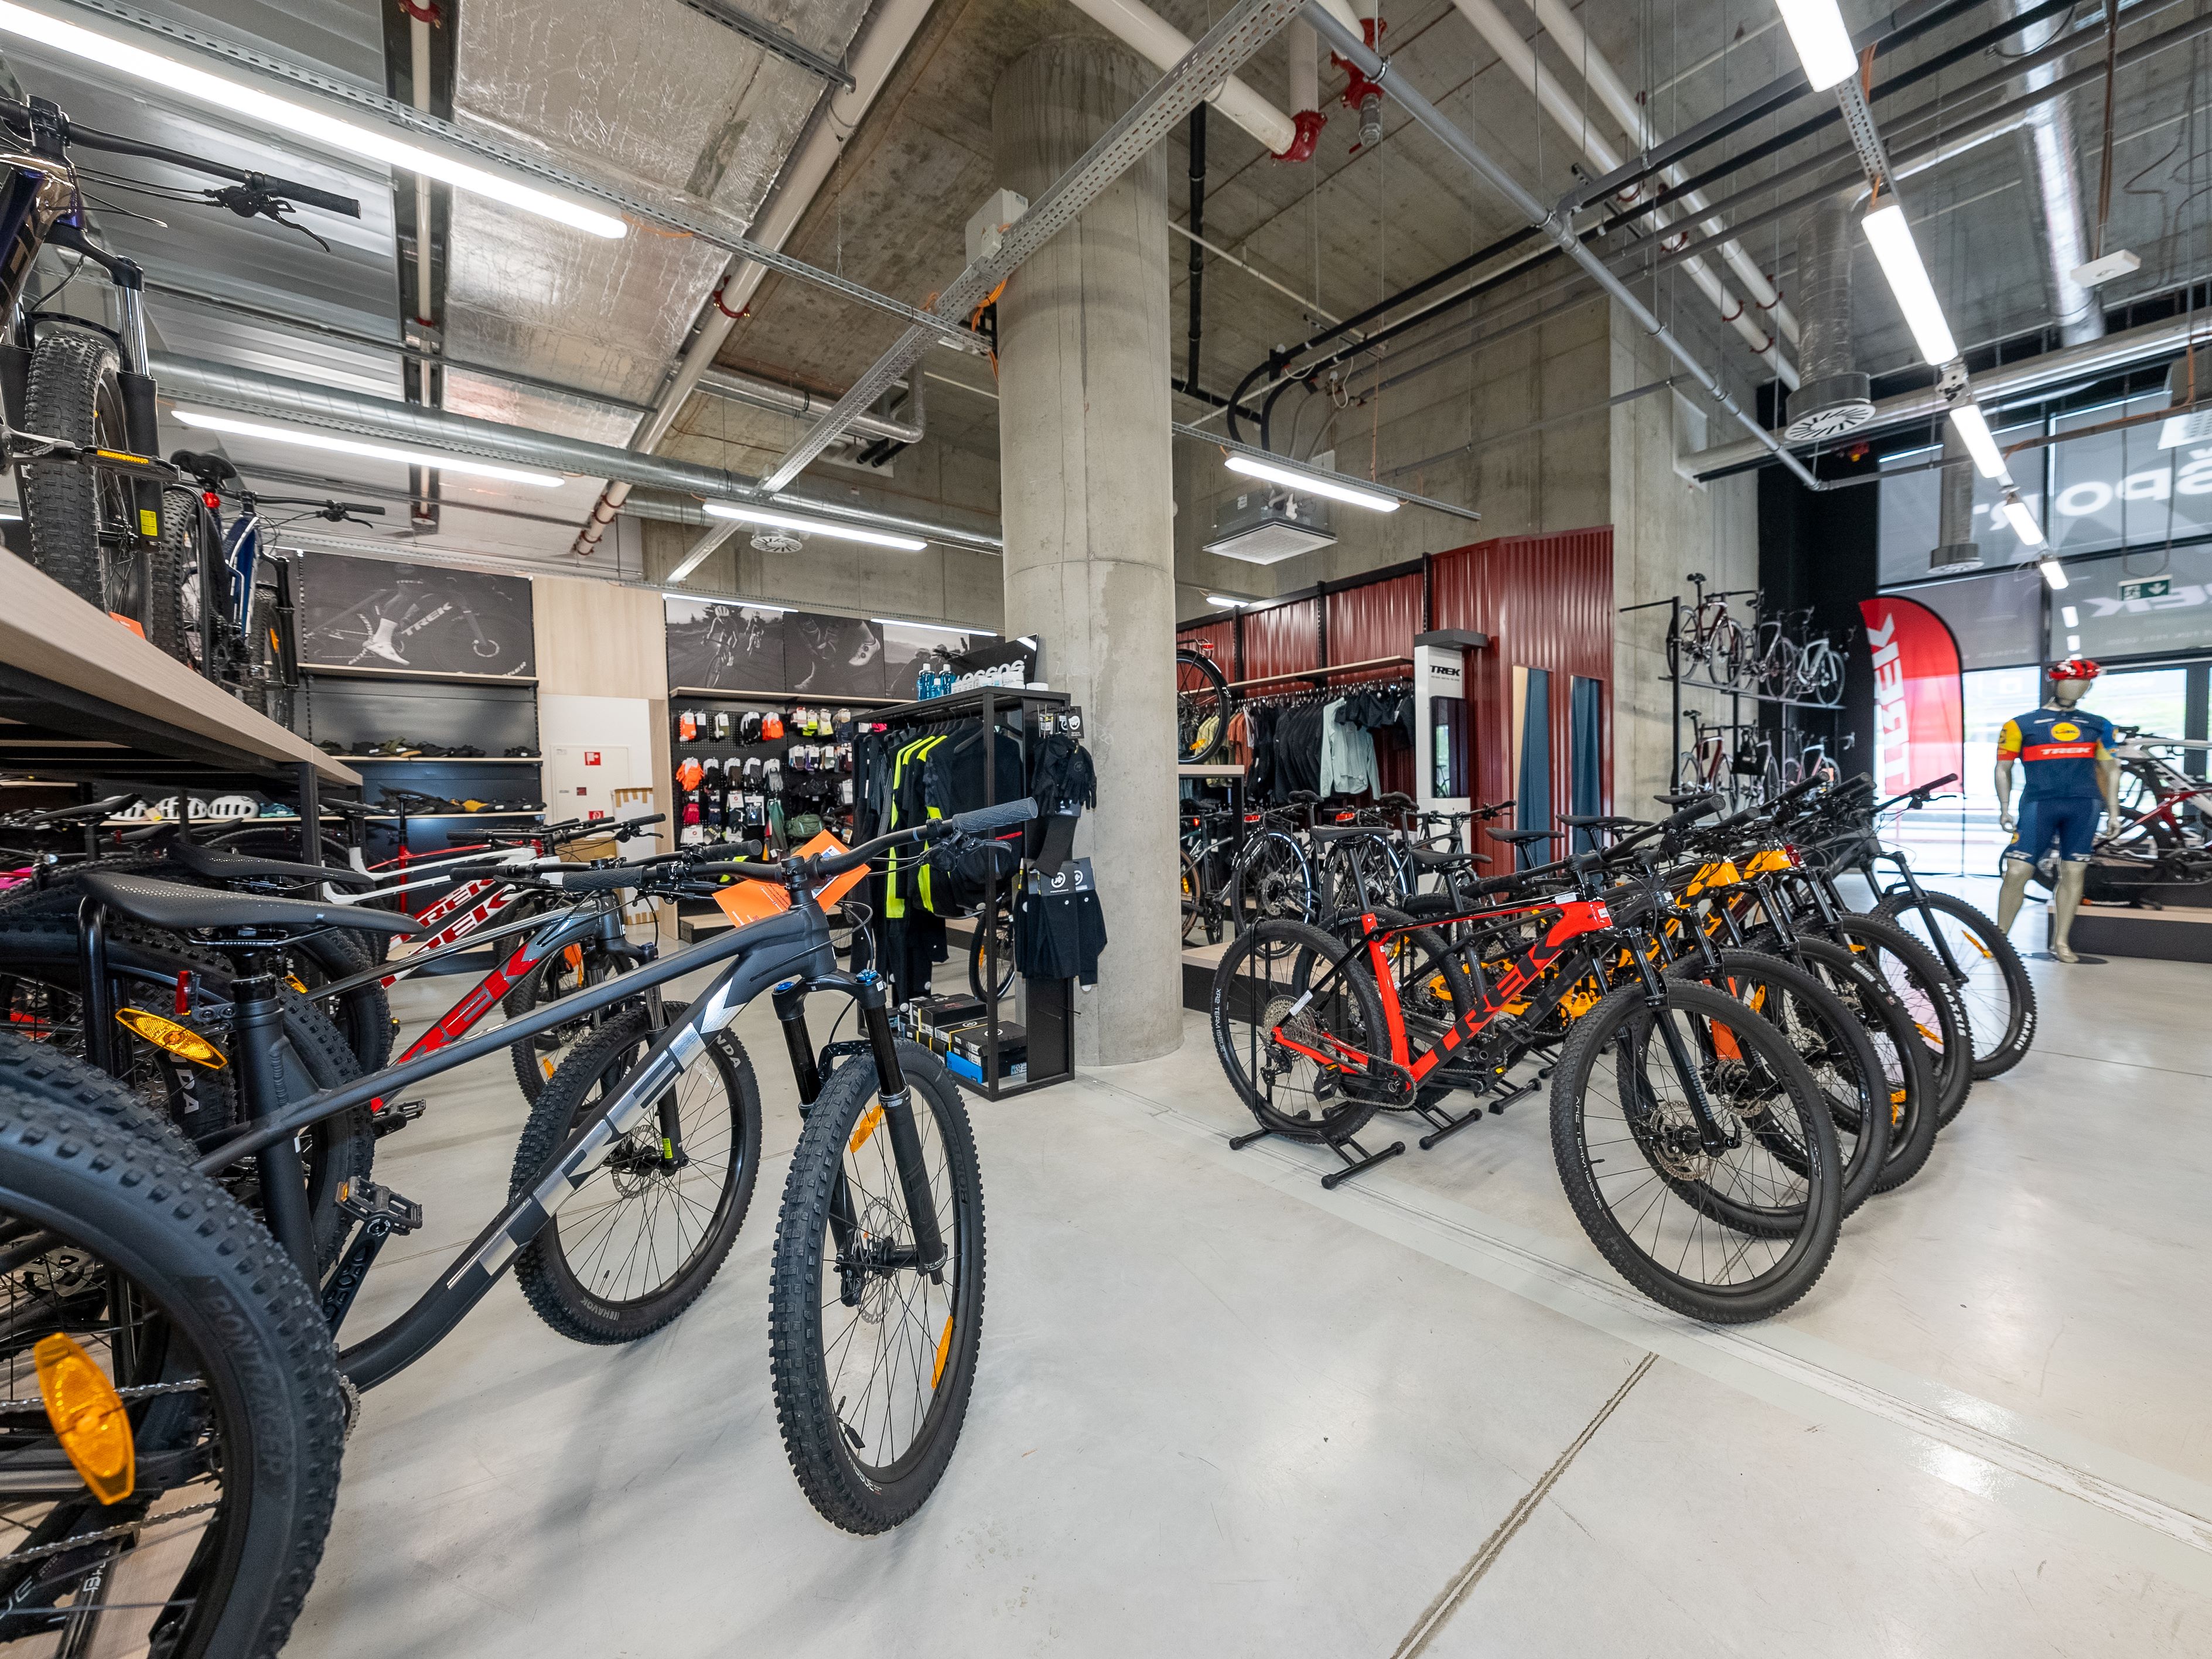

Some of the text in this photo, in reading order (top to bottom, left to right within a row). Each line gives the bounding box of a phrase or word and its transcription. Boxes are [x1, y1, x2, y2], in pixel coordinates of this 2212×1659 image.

[401, 600, 453, 636] TREK
[1430, 665, 1461, 676] TREK
[1867, 613, 1910, 786] TREK
[2041, 747, 2091, 755] TREK
[397, 943, 540, 1064] REK
[1421, 934, 1565, 1063] TREK
[1938, 982, 1967, 1037] MAXXIS
[1216, 1029, 1226, 1053] ISSUE
[2013, 1012, 2033, 1051] MAXXIS
[716, 1034, 741, 1069] NDA
[447, 977, 748, 1288] TREK
